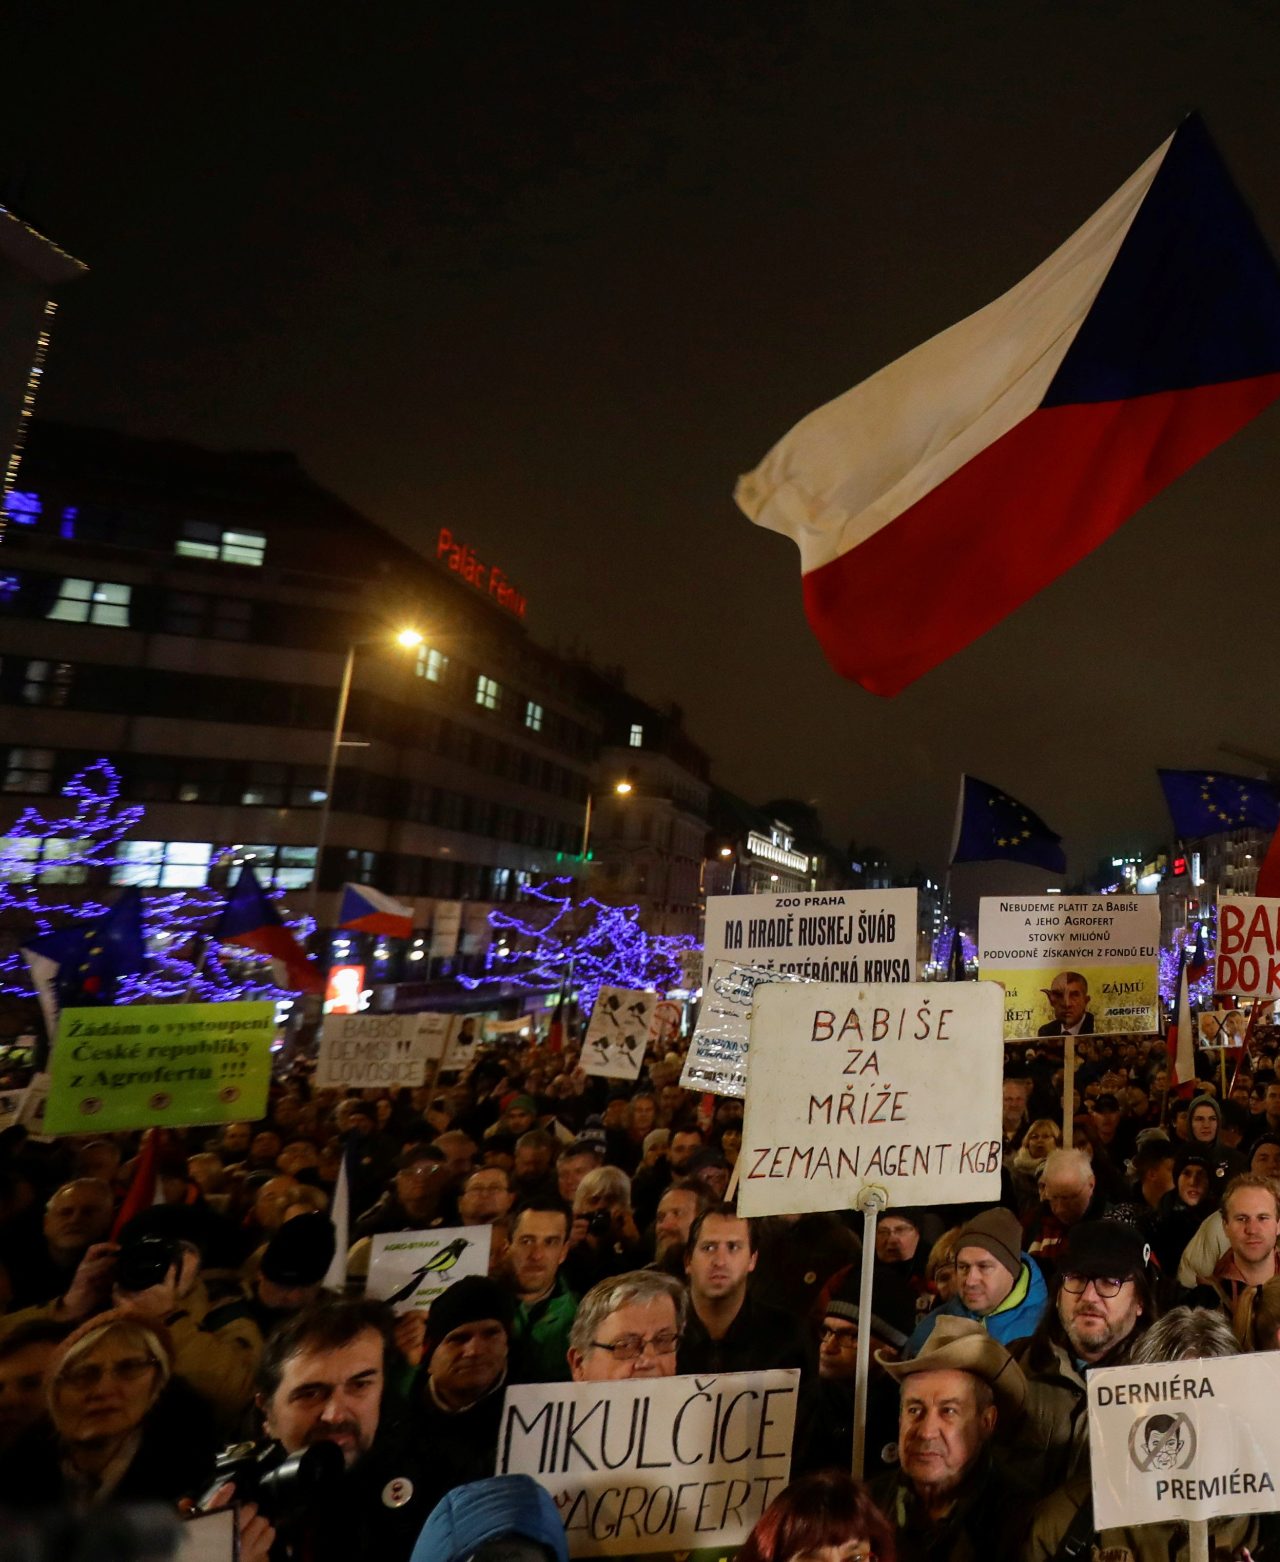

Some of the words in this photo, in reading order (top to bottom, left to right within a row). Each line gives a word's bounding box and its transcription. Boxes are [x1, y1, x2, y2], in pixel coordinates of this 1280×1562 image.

[775, 898, 800, 908] ZOO
[804, 896, 846, 907] PRAHA
[1092, 902, 1103, 912] ZA
[724, 920, 743, 949] NA
[747, 913, 794, 948] HRADĚ
[799, 915, 852, 946] RUSKEJ
[858, 909, 896, 944] ŠVÁB
[1024, 917, 1031, 926] A
[1036, 917, 1060, 926] JEHO
[1064, 916, 1114, 926] AGROFERT
[1028, 933, 1065, 942] STOVKY
[983, 947, 1038, 959] PODVODNĚ
[1043, 946, 1093, 957] ZÍSKANÝCH
[1105, 945, 1137, 957] FONDŮ
[1217, 954, 1260, 992] DO
[1102, 981, 1144, 994] ZÁJMŮ
[811, 1000, 954, 1041] BABIŠE
[1004, 1009, 1033, 1022] ŘET
[1105, 1007, 1150, 1016] AGROFERT
[68, 1019, 142, 1038] Žádám
[146, 1023, 160, 1034] o
[165, 1016, 271, 1035] vystoupení
[71, 1042, 142, 1061] České
[147, 1039, 251, 1061] republiky
[842, 1049, 880, 1076] ZA
[69, 1075, 84, 1088] z
[91, 1065, 212, 1089] Agrofertu
[220, 1061, 247, 1078] !!!
[808, 1083, 908, 1125] MŘÍŽE
[747, 1146, 859, 1180] ZEMAN
[864, 1144, 952, 1177] AGENT
[959, 1141, 1001, 1174] KGB
[1097, 1374, 1215, 1406] DERNIÉRA
[501, 1378, 794, 1474] MIKULČICE
[1156, 1468, 1274, 1500] PREMIÉRA
[564, 1477, 784, 1541] AGROFERT
